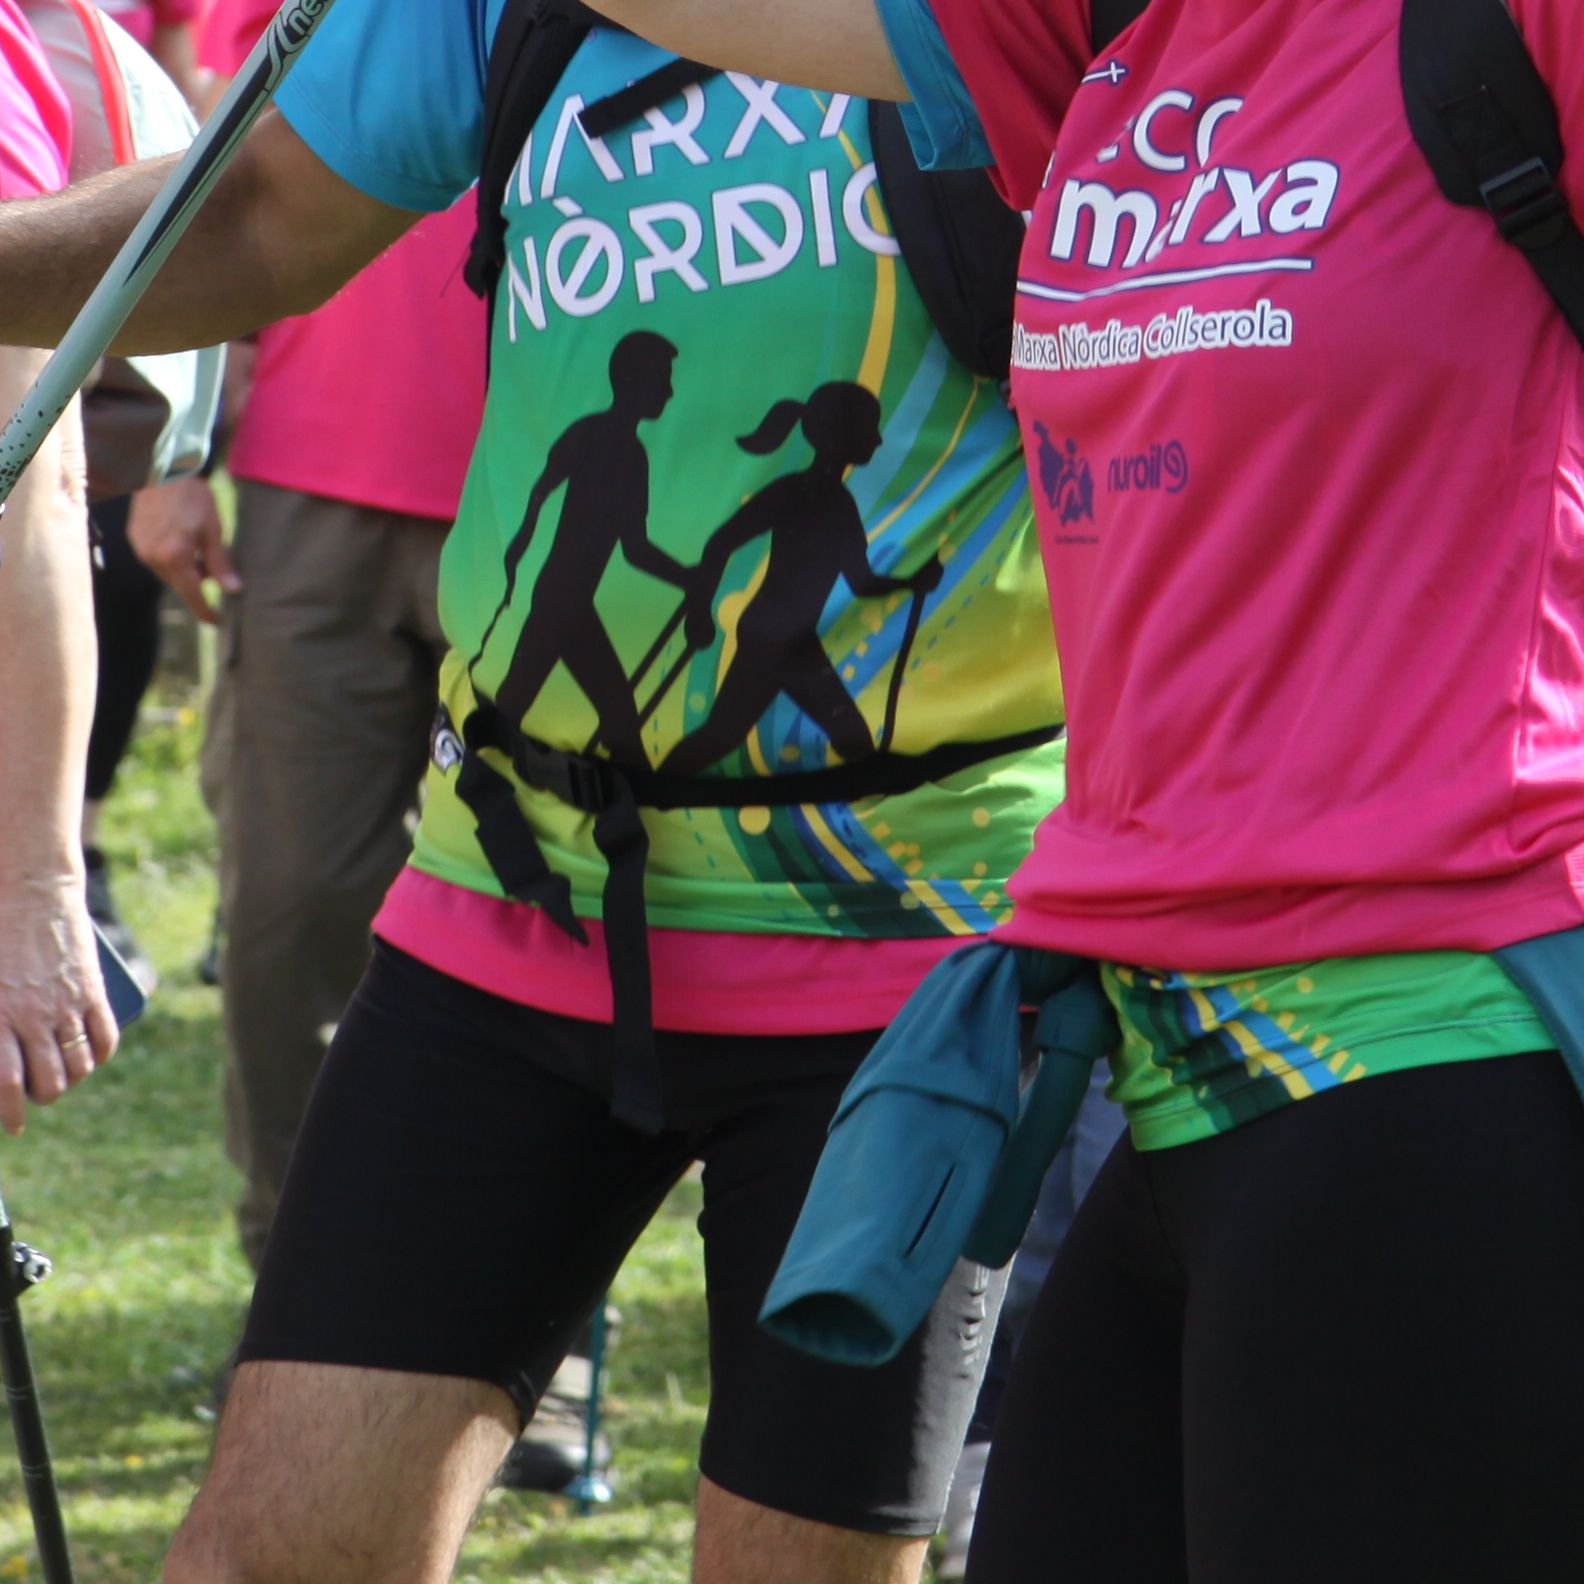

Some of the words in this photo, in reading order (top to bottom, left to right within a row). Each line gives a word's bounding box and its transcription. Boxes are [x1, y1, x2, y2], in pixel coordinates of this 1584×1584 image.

[1048, 158, 1340, 269] mrxa
[1060, 320, 1142, 369] Nòrdica
[1142, 298, 1293, 359] Collserola
[1107, 443, 1161, 494] nuroil
